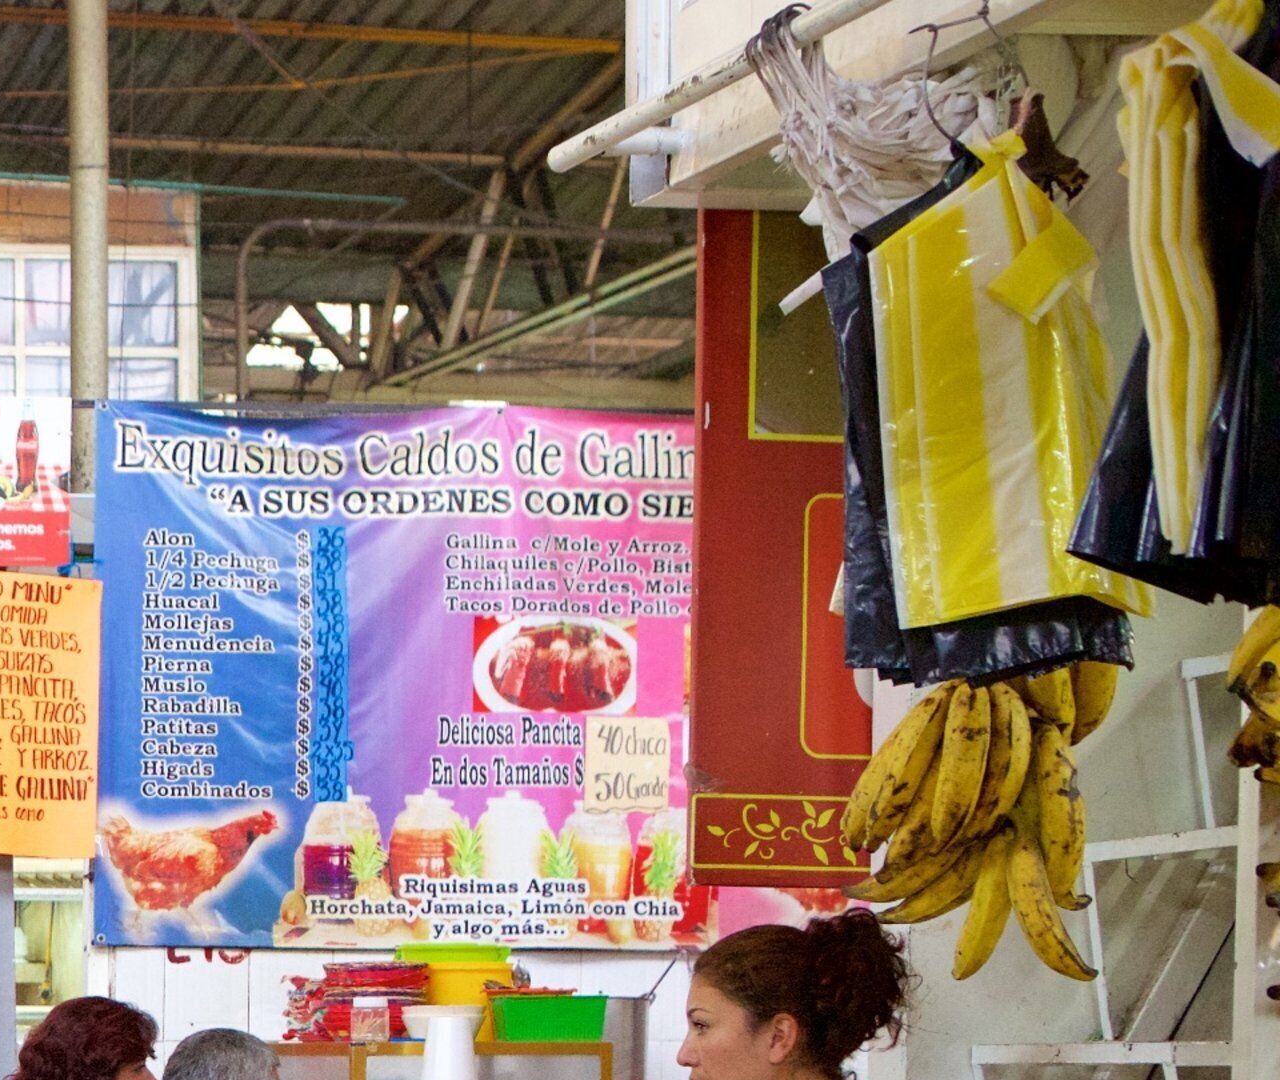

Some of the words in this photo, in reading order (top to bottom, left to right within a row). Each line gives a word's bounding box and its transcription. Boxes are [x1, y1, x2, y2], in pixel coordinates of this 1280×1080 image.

[117, 422, 343, 485] Exquisitos
[358, 430, 500, 477] Caldos
[515, 428, 561, 476] de
[263, 490, 329, 514] SUS
[343, 490, 512, 514] ORDENES
[525, 491, 628, 517] COMO
[642, 493, 694, 518] SIE
[146, 530, 193, 546] Alon
[446, 534, 517, 550] Gallina
[532, 535, 600, 552] c/Mole
[609, 540, 619, 555] y
[146, 551, 184, 568] 1/4
[193, 551, 278, 573] Pechuga
[446, 555, 558, 575] Chilaquiles
[565, 557, 644, 576] c/Pollo,
[146, 572, 184, 589] 1/2
[193, 572, 278, 594] Pechuga
[446, 576, 556, 592] Enchiladas
[564, 578, 636, 595] Verdes,
[145, 594, 218, 609] Huacal
[446, 597, 503, 613] Tacos
[512, 597, 591, 613] Dorados
[598, 597, 622, 614] de
[631, 598, 680, 615] Pollo
[144, 614, 232, 635] Mollejas
[144, 635, 274, 652] Menudencia
[143, 656, 211, 672] Pierna
[143, 677, 205, 693] Muslo
[32, 700, 87, 725] TACOS
[143, 698, 241, 714] Rabadilla
[9, 724, 81, 746] GALLINA
[143, 718, 216, 735] Patitas
[439, 716, 514, 746] Deliciosa
[522, 716, 582, 746] Pancita
[142, 740, 216, 756] Cabeza
[142, 760, 213, 780] Higads
[431, 757, 453, 786] En
[459, 758, 488, 786] dos
[493, 757, 570, 786] Tamaños
[142, 781, 272, 798] Combinados
[526, 878, 587, 897] Aguas
[310, 899, 414, 918] Horchata,
[421, 899, 512, 918] Jamaica,
[521, 898, 586, 916] Limón
[593, 901, 626, 916] con
[433, 922, 445, 938] y
[451, 921, 493, 938] algo
